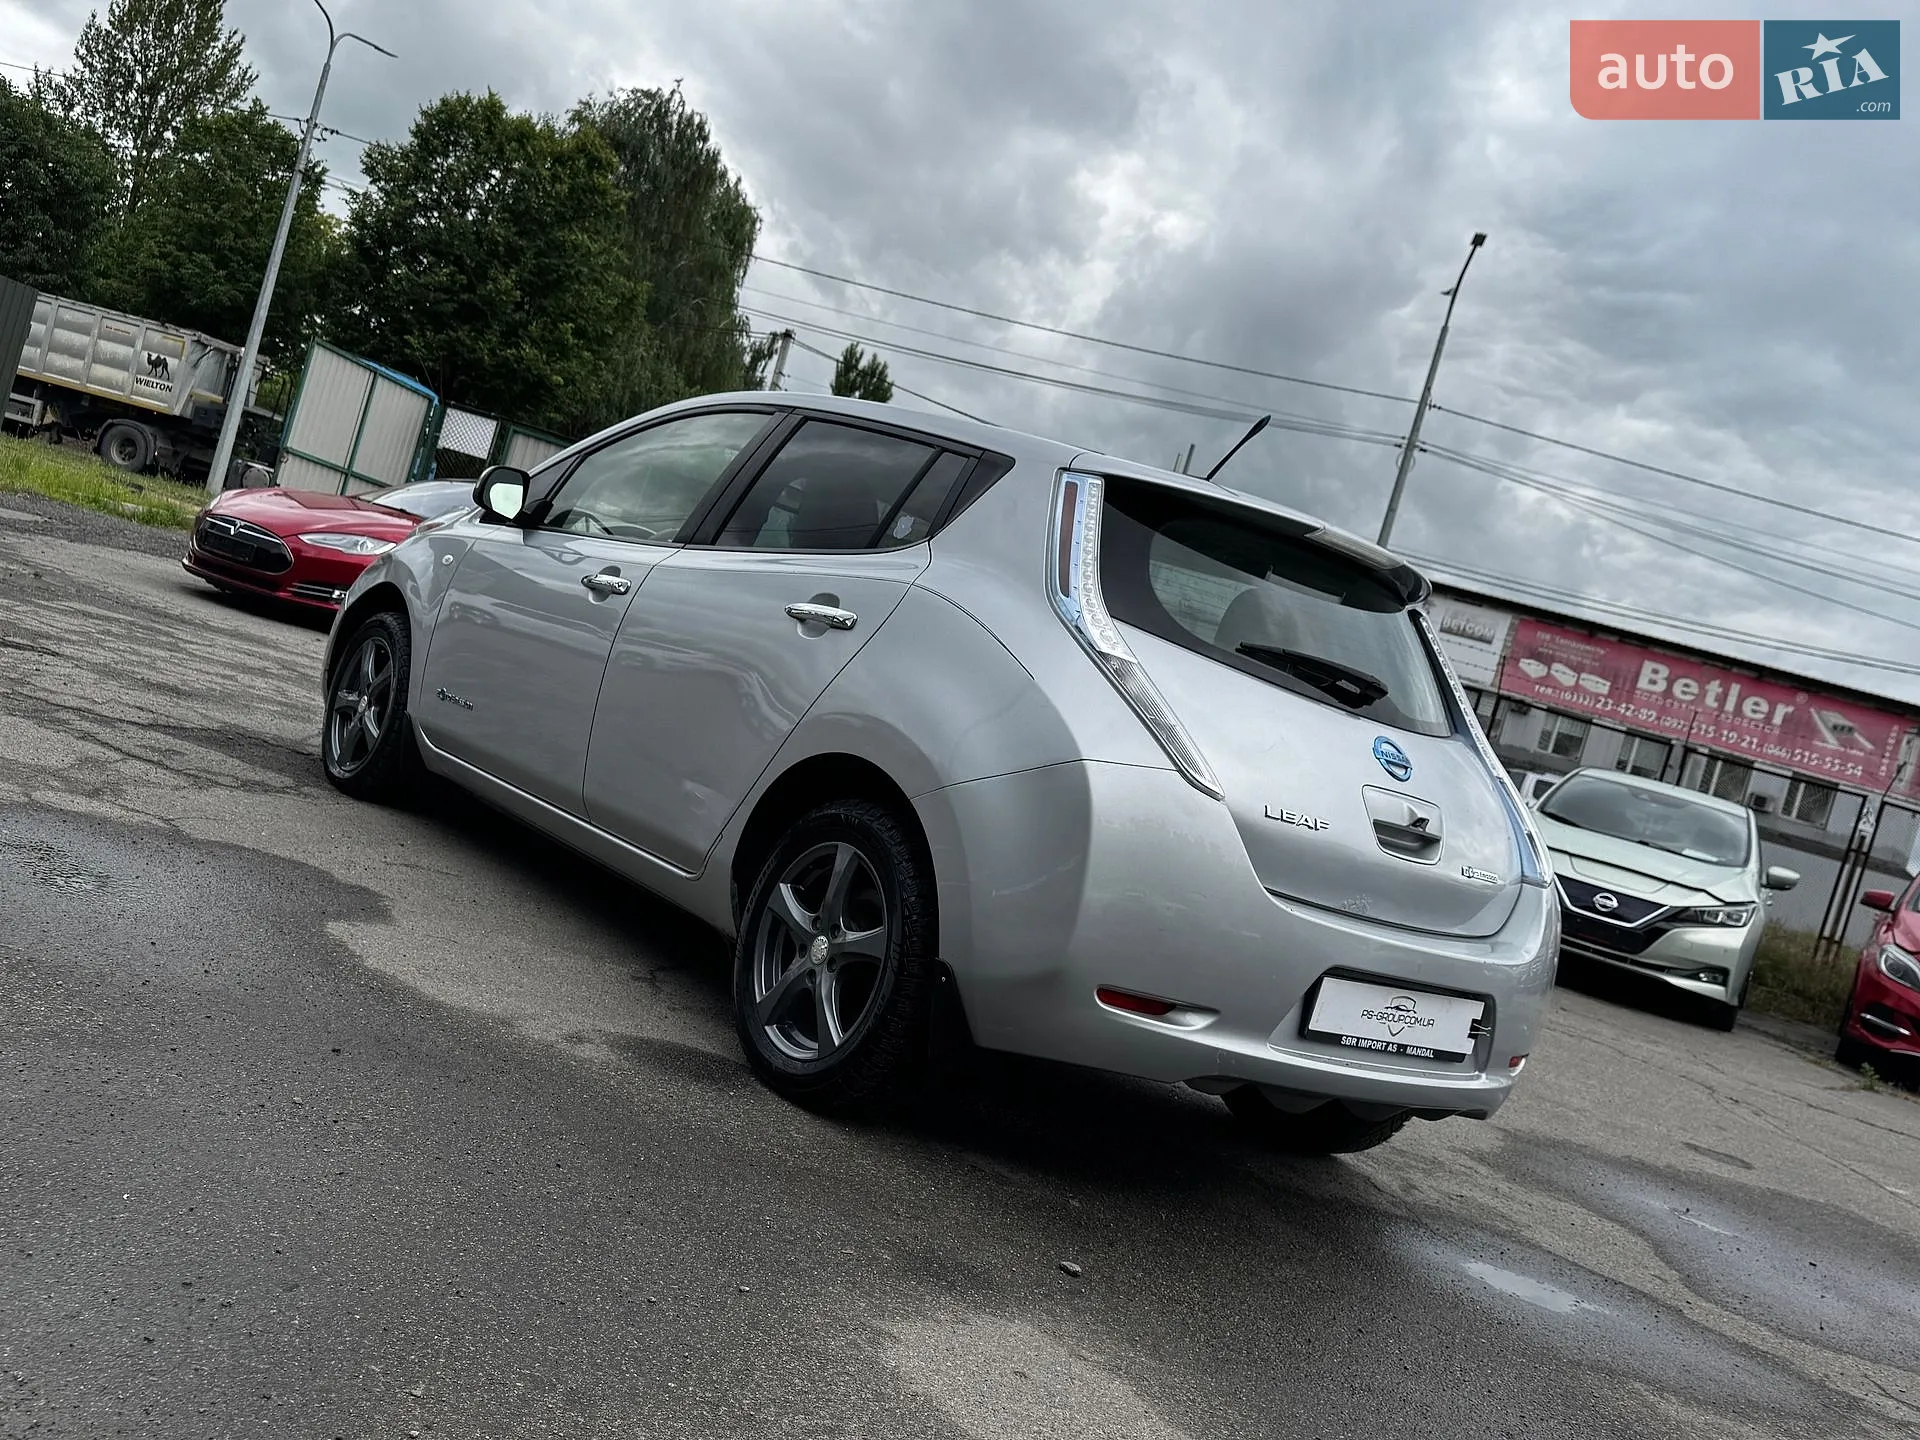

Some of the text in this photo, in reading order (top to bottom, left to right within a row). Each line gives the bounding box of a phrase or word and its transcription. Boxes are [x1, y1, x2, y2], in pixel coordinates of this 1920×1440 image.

[135, 377, 173, 393] WIELTON
[1636, 659, 1795, 726] Betler
[1264, 805, 1331, 831] LEAF
[1340, 1035, 1357, 1047] SØR
[1357, 1037, 1387, 1051] IMPORT
[1386, 1042, 1398, 1052] AS
[1405, 1045, 1434, 1058] MANDAL
